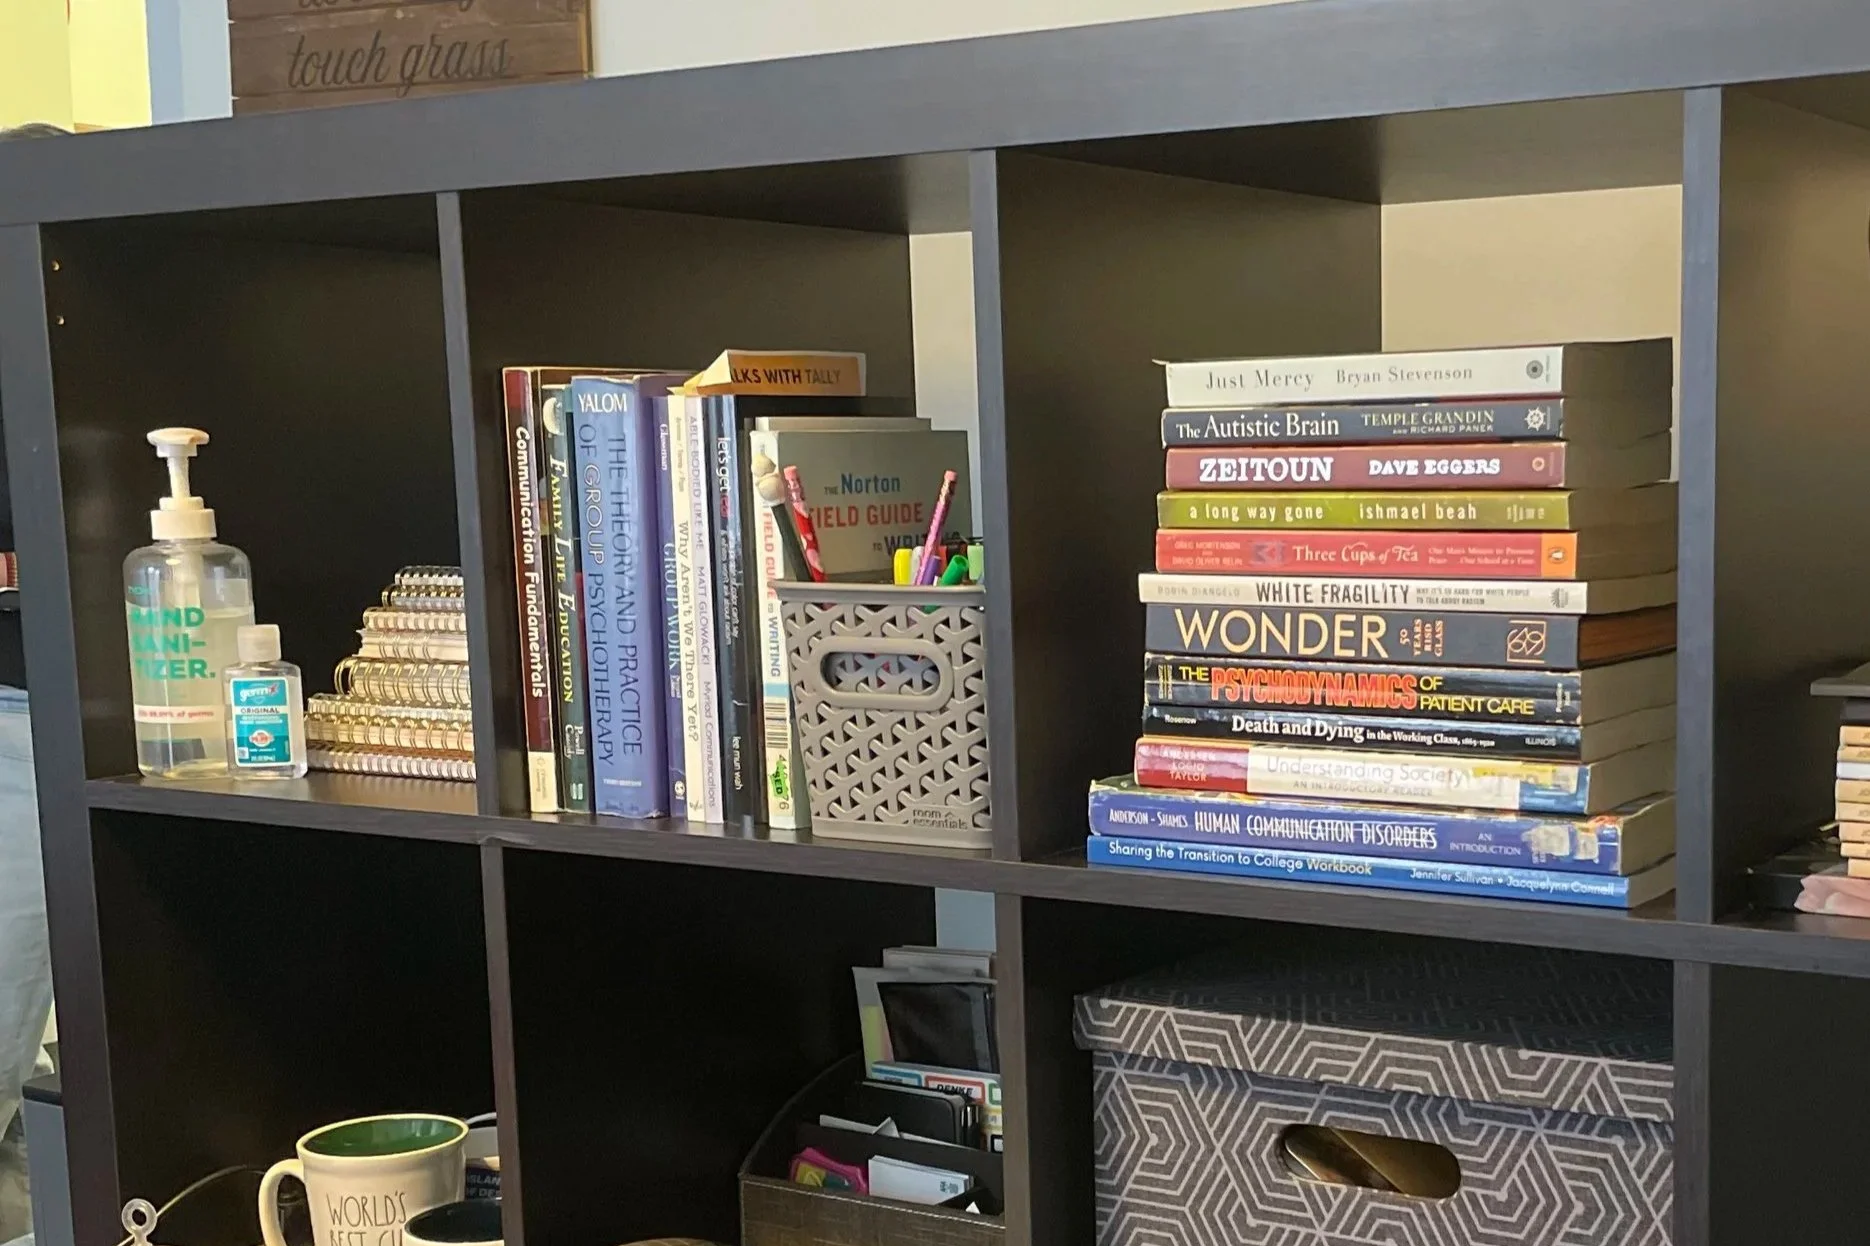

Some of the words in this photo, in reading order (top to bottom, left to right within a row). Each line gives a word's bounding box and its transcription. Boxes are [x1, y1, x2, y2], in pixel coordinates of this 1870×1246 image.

[289, 29, 391, 89] touch
[397, 34, 512, 98] grass
[763, 368, 802, 384] WITH
[805, 368, 840, 384] TALLY
[1206, 371, 1245, 389] Just
[1254, 369, 1315, 392] Mercy
[1336, 368, 1381, 387] Bryan
[1388, 365, 1473, 382] Stevenson
[578, 393, 628, 413] YALOM
[578, 423, 598, 458] OF
[1175, 423, 1201, 439] The
[1204, 414, 1280, 439] Autistic
[1286, 411, 1340, 437] Brain
[1360, 412, 1419, 427] TEMPLE
[1422, 410, 1495, 425] GRANDIN
[608, 434, 628, 480] THE
[717, 437, 732, 464] let's
[716, 466, 732, 495] get
[824, 486, 838, 495] THE
[841, 473, 901, 495] Norton
[1200, 456, 1334, 482] ZEITOUN
[1369, 459, 1419, 476] DAVE
[1424, 457, 1501, 475] EGGERS
[515, 426, 536, 565] Communication
[550, 453, 569, 530] FAMILY
[583, 463, 605, 566] GROUP
[867, 502, 924, 526] GUIDE
[1189, 506, 1198, 519] a
[1205, 503, 1240, 522] long
[1246, 505, 1277, 522] way
[1285, 505, 1325, 523] gone
[1359, 502, 1427, 520] ishmael
[1435, 503, 1478, 520] beah
[610, 491, 634, 582] THEORY
[678, 520, 690, 559] Why
[763, 511, 775, 553] FIELD
[1292, 545, 1337, 562] Three
[1341, 541, 1376, 566] Cups
[1378, 549, 1389, 563] of
[1391, 545, 1419, 562] Tea
[680, 563, 693, 618] Aren't
[696, 566, 708, 597] MATT
[1256, 581, 1314, 603] WHITE
[1321, 583, 1410, 605] FRAGILITY
[615, 585, 637, 635] AND
[524, 571, 547, 698] Fundamentals
[558, 589, 577, 704] EDUCATION
[684, 620, 695, 647] We
[699, 600, 711, 666] GLOWACKI
[768, 616, 781, 678] WRITING
[1174, 608, 1389, 659] WONDER
[1414, 618, 1423, 657] YEARS
[1434, 619, 1444, 657] GLASS
[588, 572, 615, 767] PSYCHOTHERAPY
[684, 650, 697, 699] There
[617, 644, 643, 756] PRACTICE
[1178, 666, 1210, 682] THE
[1210, 666, 1418, 711] PSYCHODYNAMICS
[1419, 676, 1444, 692] OF
[240, 707, 281, 715] ORIGINAL
[1419, 696, 1485, 714] PATIENT
[1486, 698, 1536, 716] CARE
[687, 704, 700, 743] Yet?
[1231, 714, 1280, 734] Death
[1281, 719, 1312, 736] and
[1314, 720, 1366, 743] Dying
[1366, 729, 1376, 740] in
[1376, 729, 1391, 742] the
[1392, 731, 1433, 746] Working
[1433, 733, 1461, 746] Class,
[574, 725, 585, 756] Powell
[772, 764, 783, 795] SED
[1170, 771, 1208, 782] TAYLOR
[1267, 756, 1394, 785] Understanding
[1399, 763, 1467, 788] Society
[1293, 780, 1307, 789] AN
[912, 809, 942, 819] room
[913, 817, 969, 830] essentials
[1109, 808, 1149, 824] ANDERSON
[1194, 811, 1241, 835] HUMAN
[1246, 814, 1355, 844] COMMUNICATION
[1361, 822, 1438, 850] DISORDERS
[1449, 842, 1521, 856] INTRODUCTION
[1477, 833, 1492, 842] AN
[1109, 842, 1153, 861] Sharing
[1155, 845, 1175, 860] the
[1177, 847, 1235, 865] Transition
[1237, 852, 1251, 866] to
[1254, 854, 1303, 874] College
[1306, 859, 1372, 876] Workbook
[1410, 867, 1452, 881] Jennifer
[1455, 871, 1494, 886] Sullivan
[1506, 875, 1569, 895] Jacquelynn
[326, 1190, 407, 1228] WORLD'S
